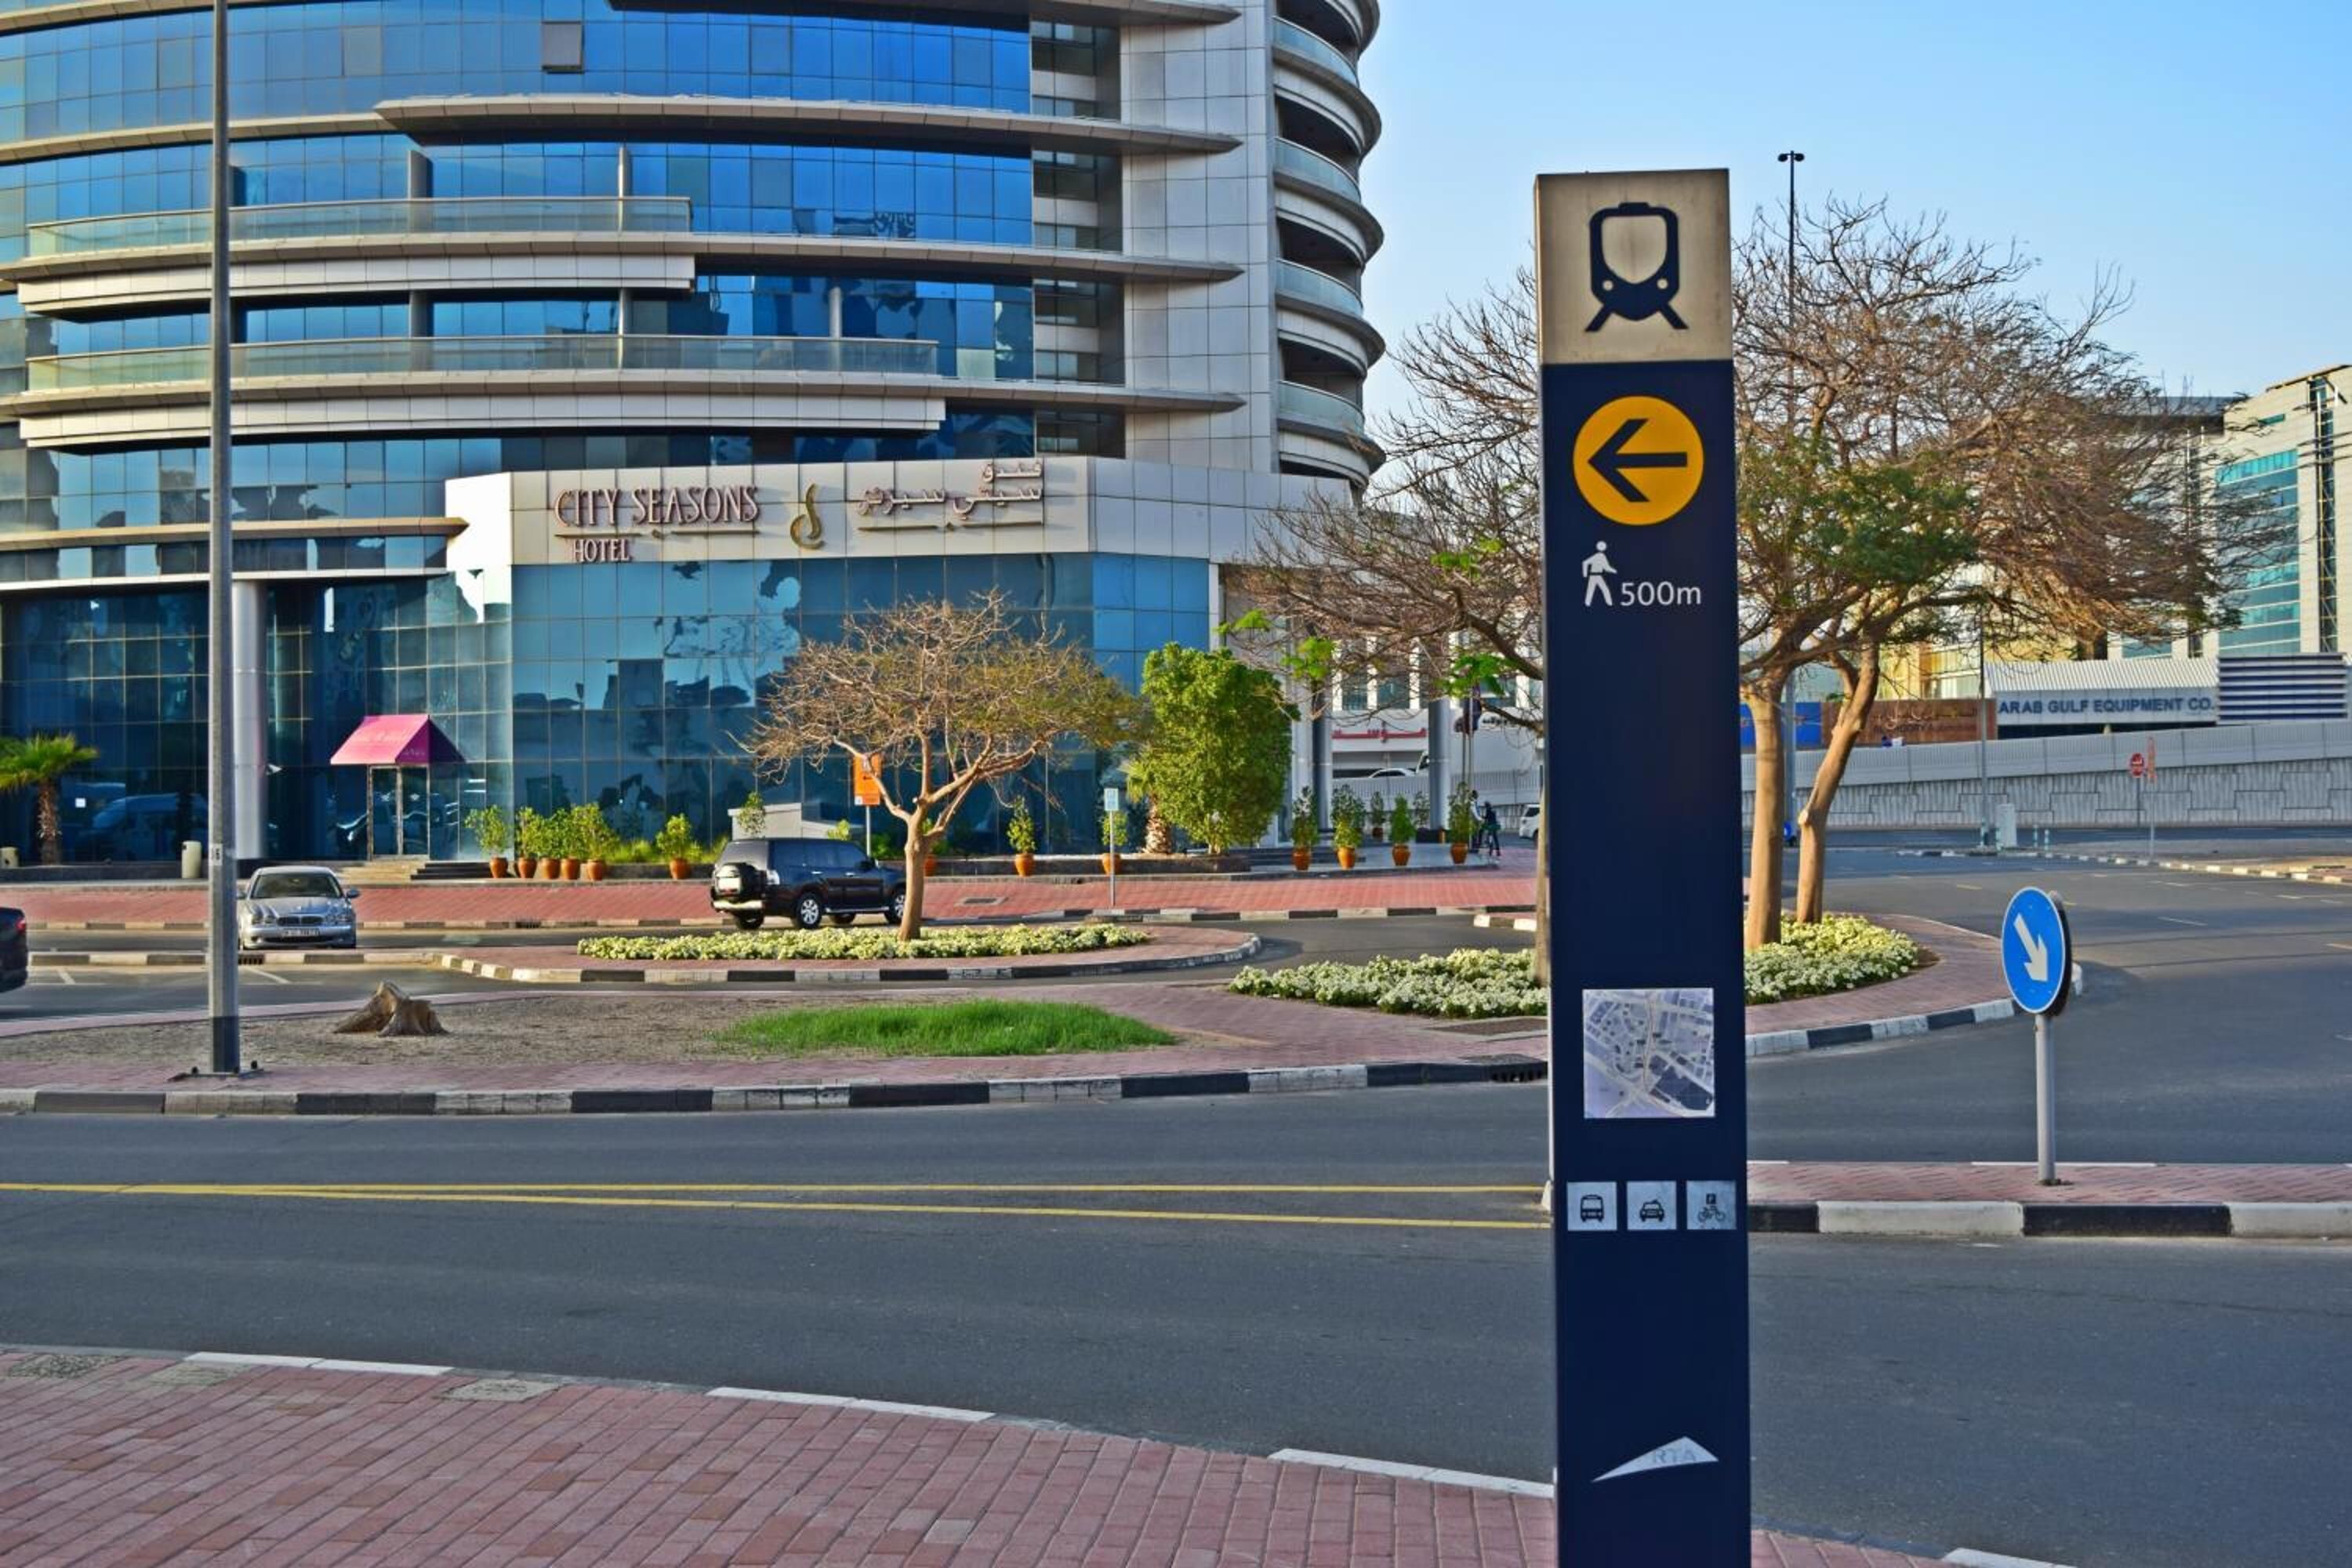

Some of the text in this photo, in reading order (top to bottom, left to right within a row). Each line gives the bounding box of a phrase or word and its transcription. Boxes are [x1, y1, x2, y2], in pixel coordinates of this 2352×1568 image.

[980, 461, 1043, 484] فندق
[554, 485, 760, 528] CITY SEASONS
[952, 486, 1044, 521] سيتي
[572, 538, 633, 564] HOTEL
[1620, 581, 1702, 607] 500m
[1998, 697, 2215, 714] ARAB GULF EQUIPMENT CO.
